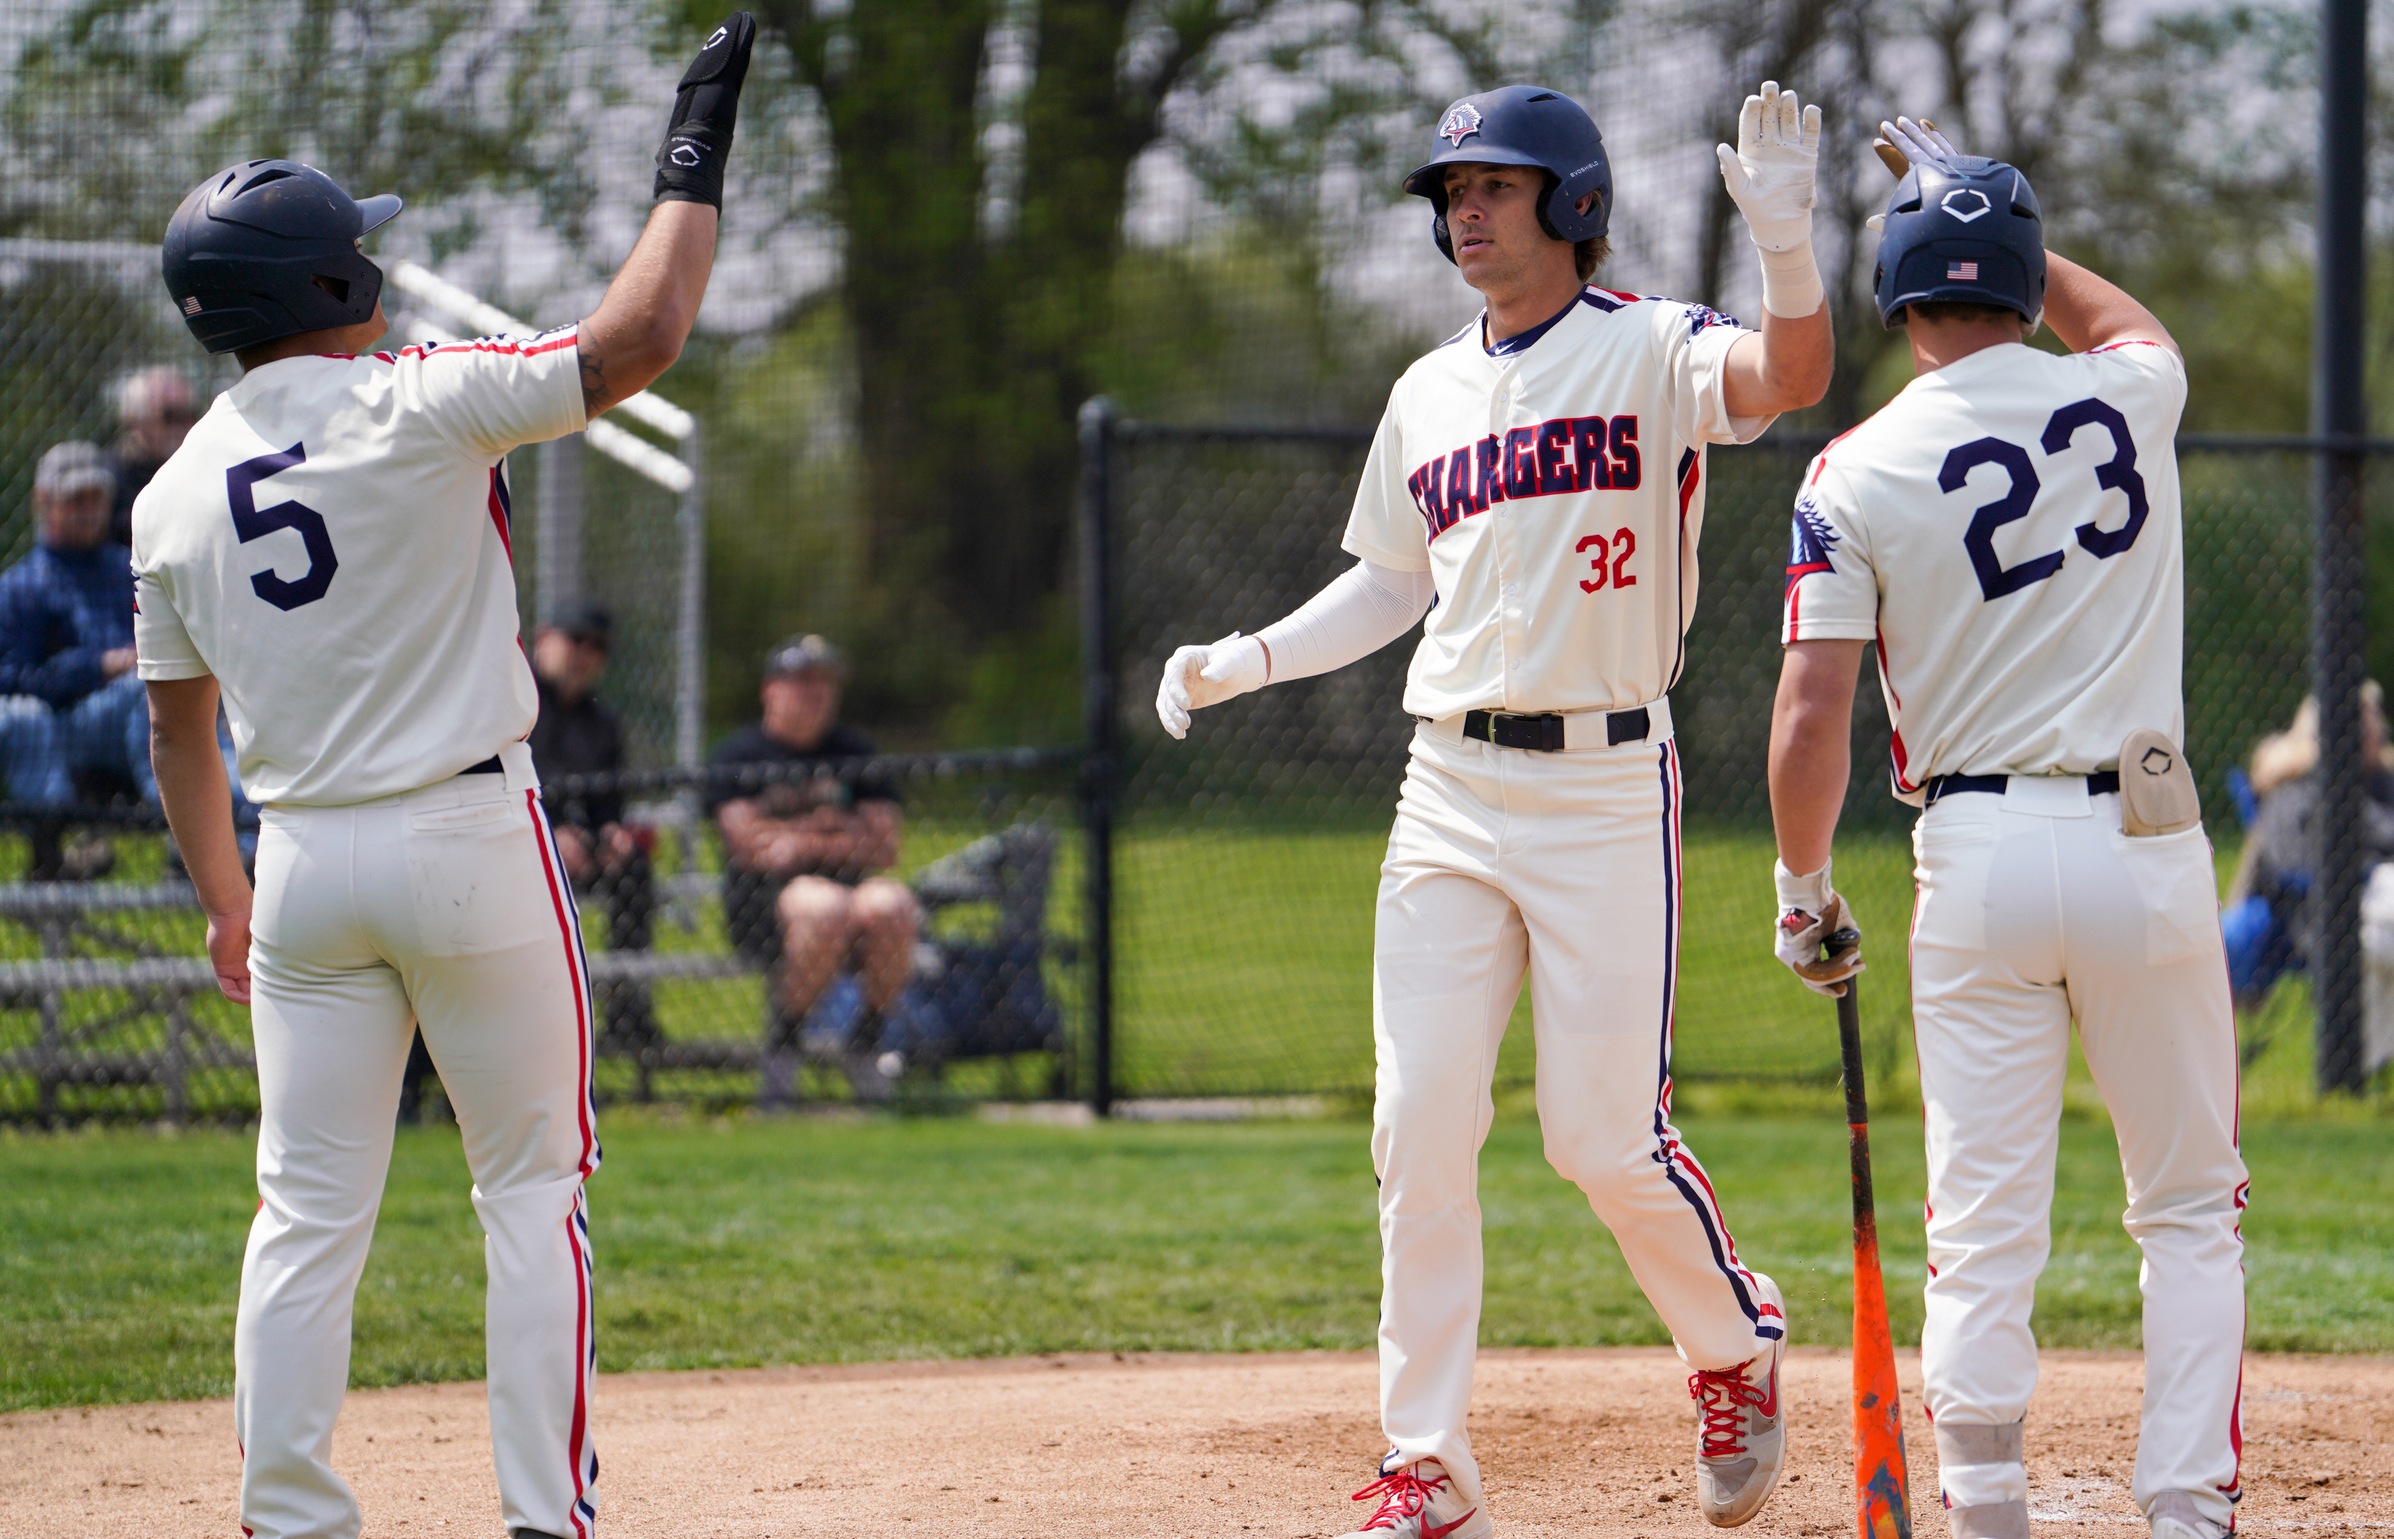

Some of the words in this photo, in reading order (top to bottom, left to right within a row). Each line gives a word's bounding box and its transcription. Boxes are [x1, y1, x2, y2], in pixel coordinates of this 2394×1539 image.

[226, 441, 339, 612] 5
[1575, 526, 1637, 595] 32
[1937, 397, 2150, 603] 23
